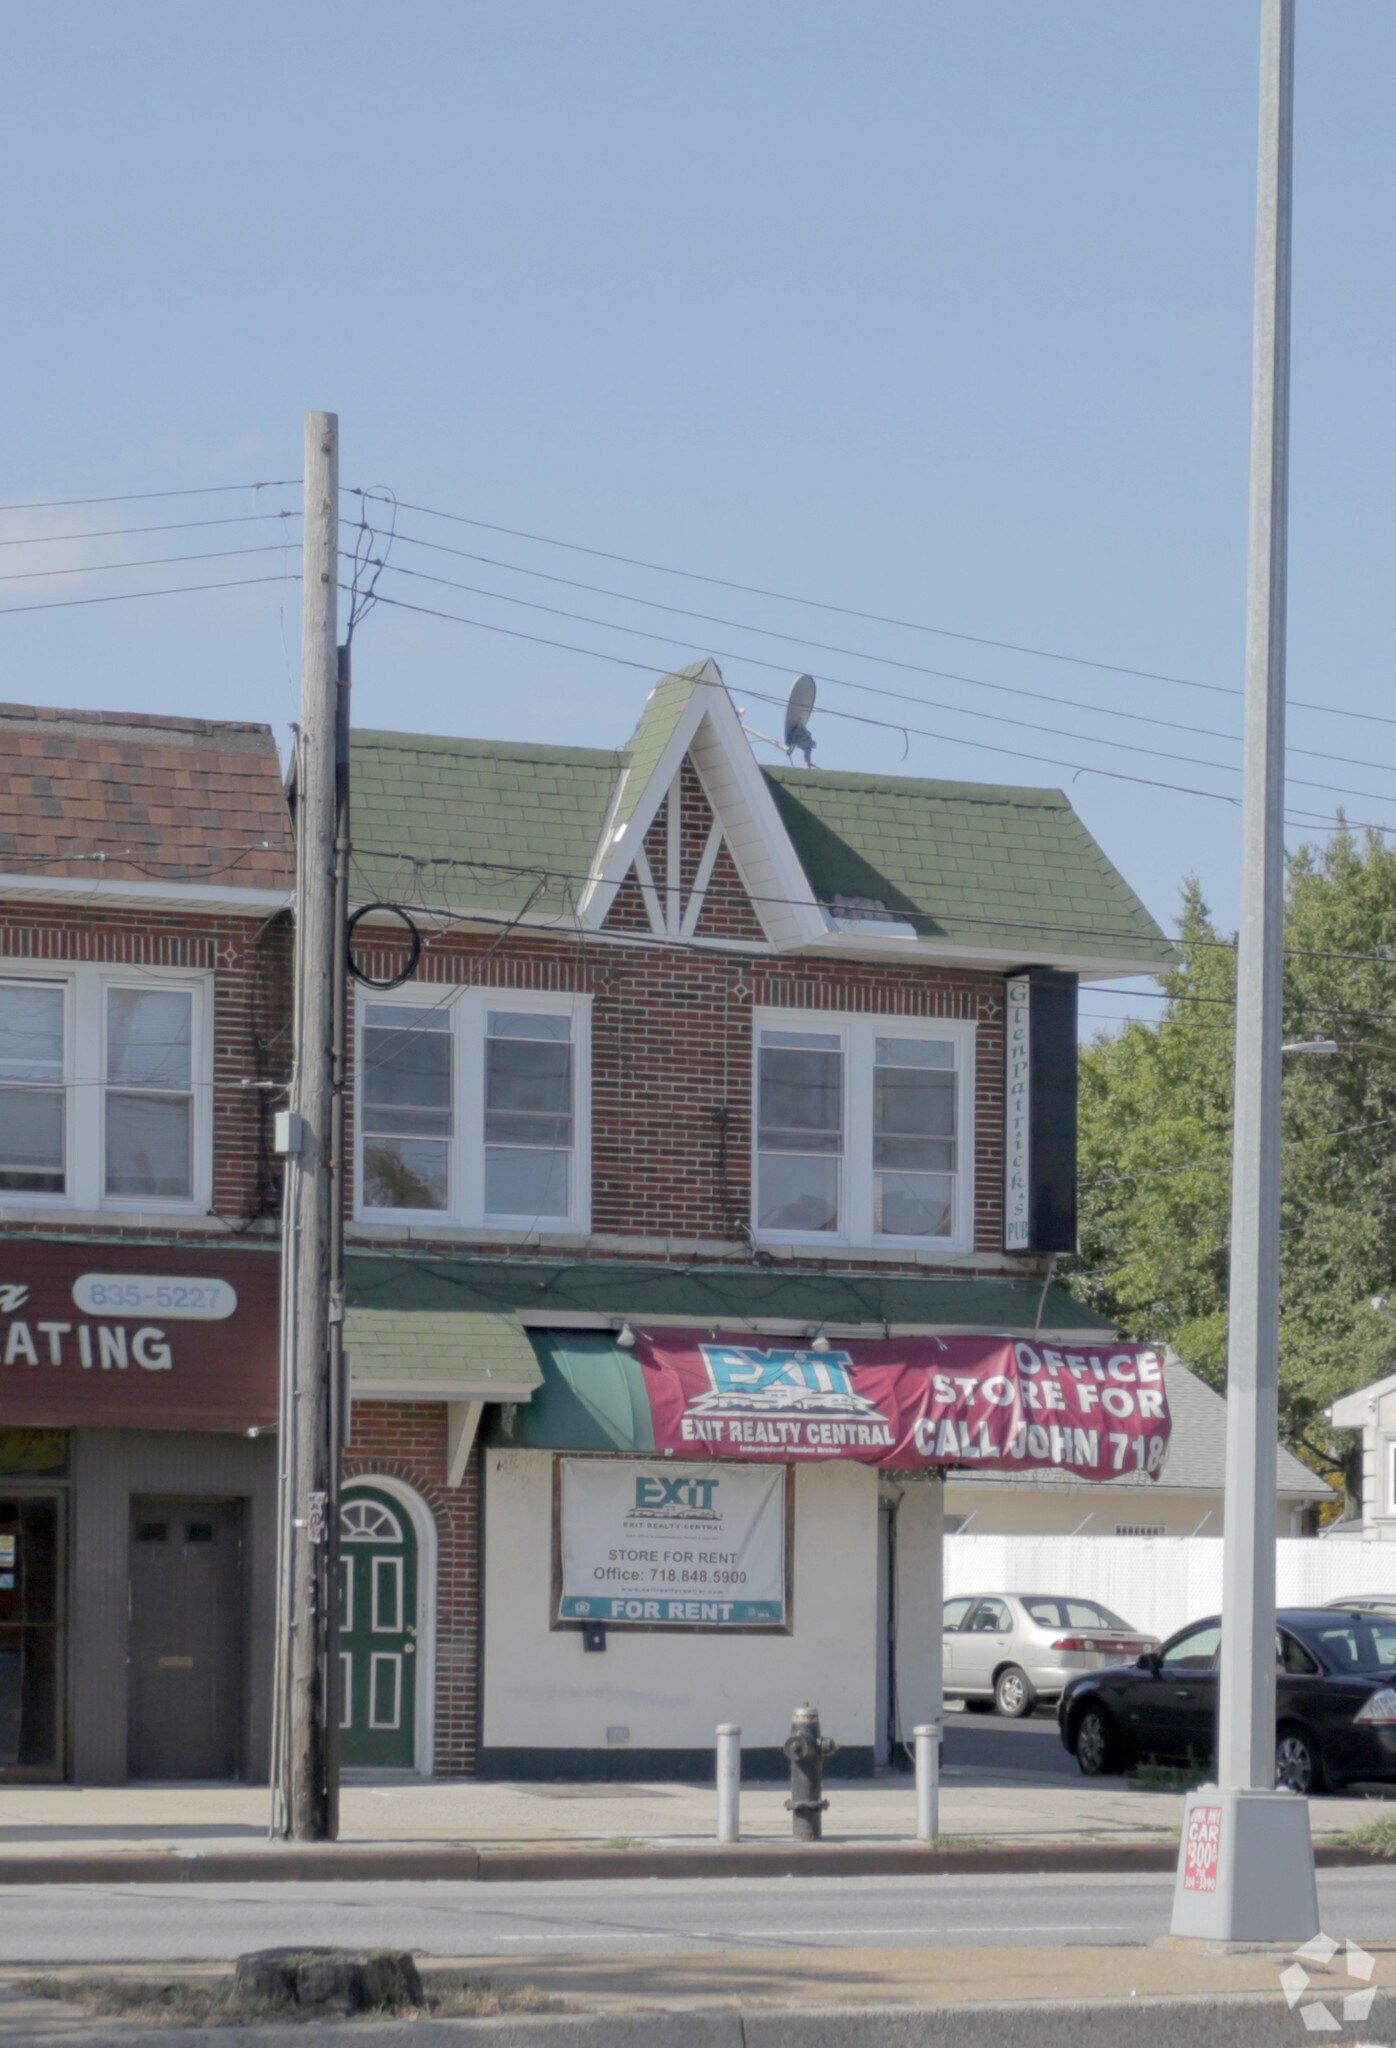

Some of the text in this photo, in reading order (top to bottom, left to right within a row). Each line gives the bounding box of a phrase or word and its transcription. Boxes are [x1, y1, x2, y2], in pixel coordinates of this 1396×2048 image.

[1008, 1221, 1028, 1241] PUB
[90, 1284, 220, 1308] 835-5227
[0, 1321, 173, 1370] ATING
[1014, 1342, 1162, 1383] OFFICE
[933, 1374, 1166, 1419] STORE FOR
[681, 1419, 896, 1445] EXIT REALTY CENTRAL
[914, 1417, 1000, 1458] CALL
[1009, 1421, 1098, 1467] JOHN
[609, 1549, 738, 1564] STORE FOR RENT
[594, 1566, 746, 1584] Office: 718.848.5900
[611, 1601, 661, 1619] FOR
[668, 1602, 734, 1620] RENT
[1189, 1823, 1219, 1842] CAR
